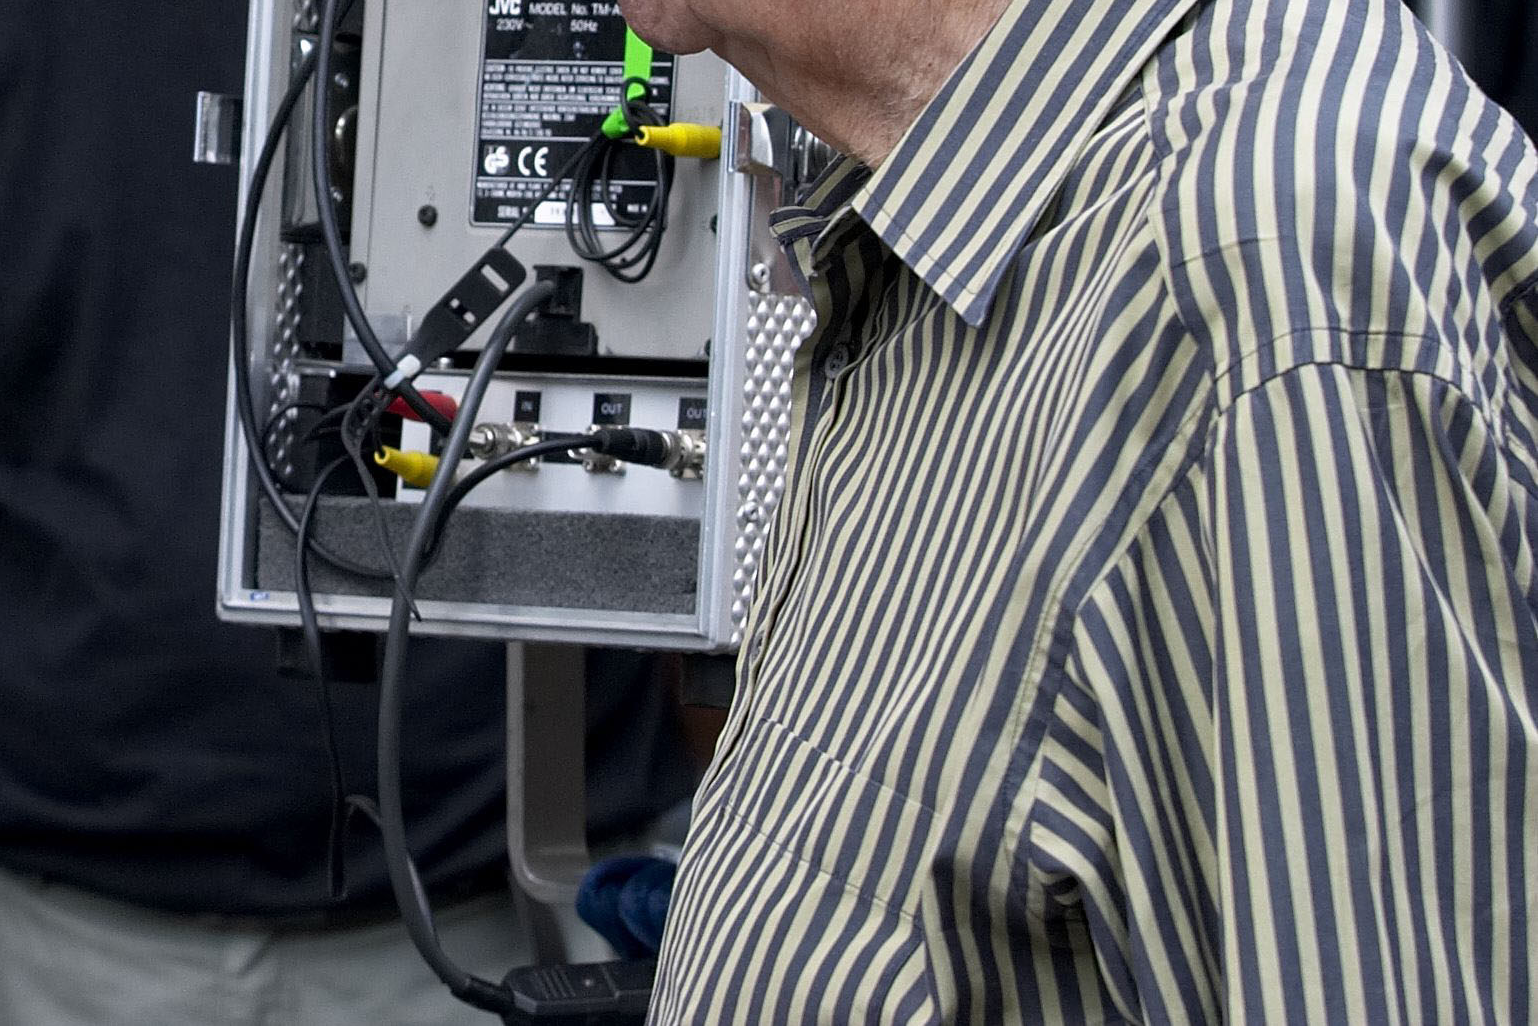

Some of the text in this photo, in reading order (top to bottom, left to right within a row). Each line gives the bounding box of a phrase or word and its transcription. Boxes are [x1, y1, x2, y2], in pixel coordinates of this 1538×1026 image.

[528, 2, 567, 16] MODEL
[569, 19, 599, 33] 50Hz
[601, 402, 623, 415] OUT
